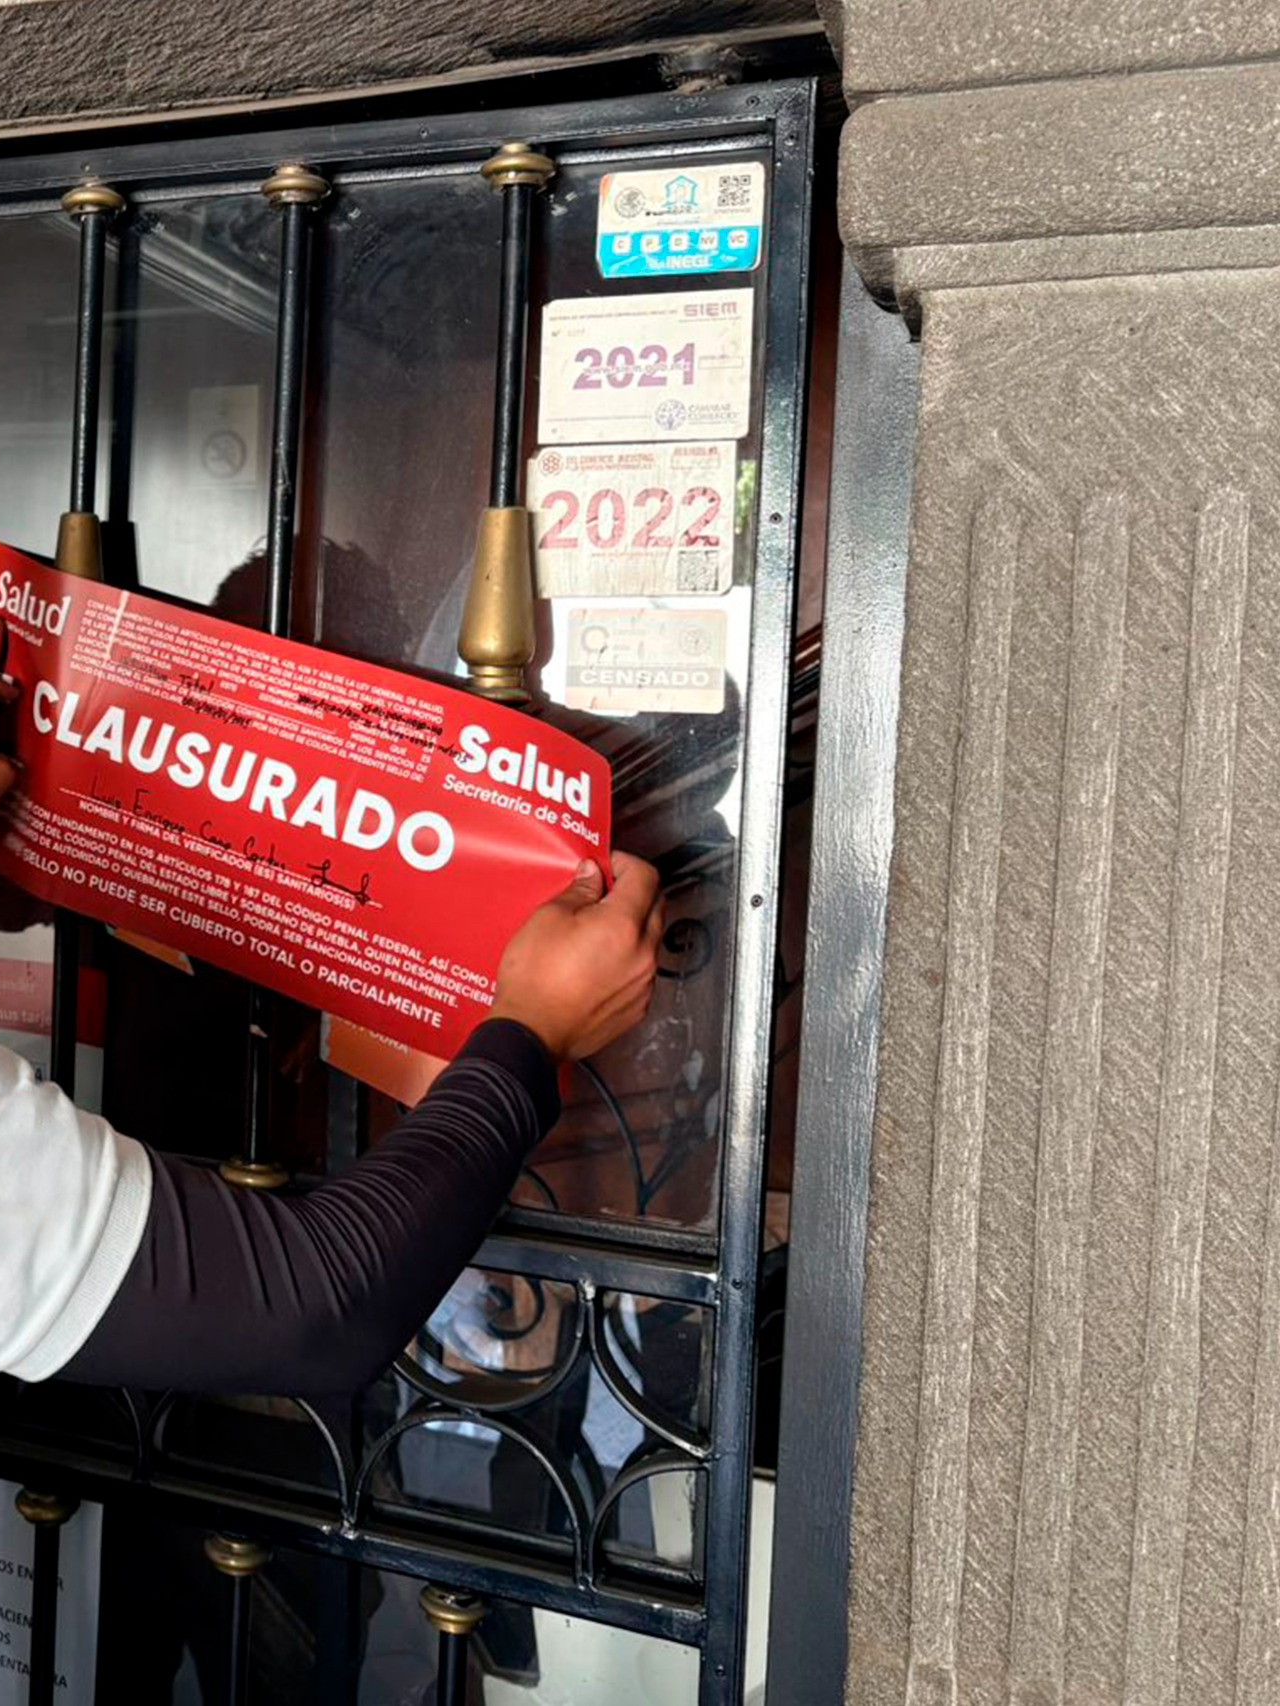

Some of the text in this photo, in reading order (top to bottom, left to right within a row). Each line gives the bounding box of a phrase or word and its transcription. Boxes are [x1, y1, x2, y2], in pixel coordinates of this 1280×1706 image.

[683, 302, 737, 317] SIEM
[573, 343, 695, 390] 2021
[538, 486, 721, 550] 2022
[579, 669, 710, 687] CENSADO
[32, 680, 455, 871] CLAUSURADO
[443, 774, 599, 846] Secretaría de Salud
[453, 724, 590, 817] Salud
[78, 801, 121, 823] NOMBRE
[120, 816, 128, 826] Y
[129, 819, 161, 837] FIRMA
[161, 831, 181, 845] DEL
[183, 838, 253, 871] VERIFICADOR
[31, 804, 51, 819] CON
[51, 812, 118, 844] FUNDAMENTO
[119, 838, 134, 850] EN
[134, 843, 155, 858] LOS
[156, 852, 212, 880] ARTÍCULOS
[231, 880, 240, 891] Y
[261, 892, 282, 907] DEL
[284, 900, 331, 926] CÓDIGO
[333, 919, 369, 941] PENAL
[371, 934, 426, 963] FEDERAL,
[428, 956, 448, 971] ASÍ
[449, 965, 488, 987] COMO
[38, 835, 52, 847] DE
[52, 840, 109, 869] AUTORIDAD
[109, 862, 120, 873] O
[120, 866, 179, 895] QUEBRANTE
[180, 889, 205, 906] ESTE
[207, 899, 242, 920] SELLO,
[282, 929, 303, 944] SER
[304, 937, 381, 976] SANCIONADO
[383, 969, 459, 1007] PENALMENTE.
[44, 824, 61, 838] DEL
[63, 831, 106, 854] CÓDIGO
[106, 847, 138, 866] PENAL
[139, 859, 158, 874] DEL
[159, 867, 199, 889] ESTADO
[200, 882, 229, 901] LIBRE
[229, 893, 238, 904] Y
[239, 897, 298, 927] SOBERANO
[299, 920, 316, 934] DE
[316, 927, 362, 952] PUEBLA,
[364, 946, 401, 967] QUIEN
[22, 850, 443, 1028] SELLO NO PUEDE SER CUBIERTO TOTAL O PARCIALMENTE
